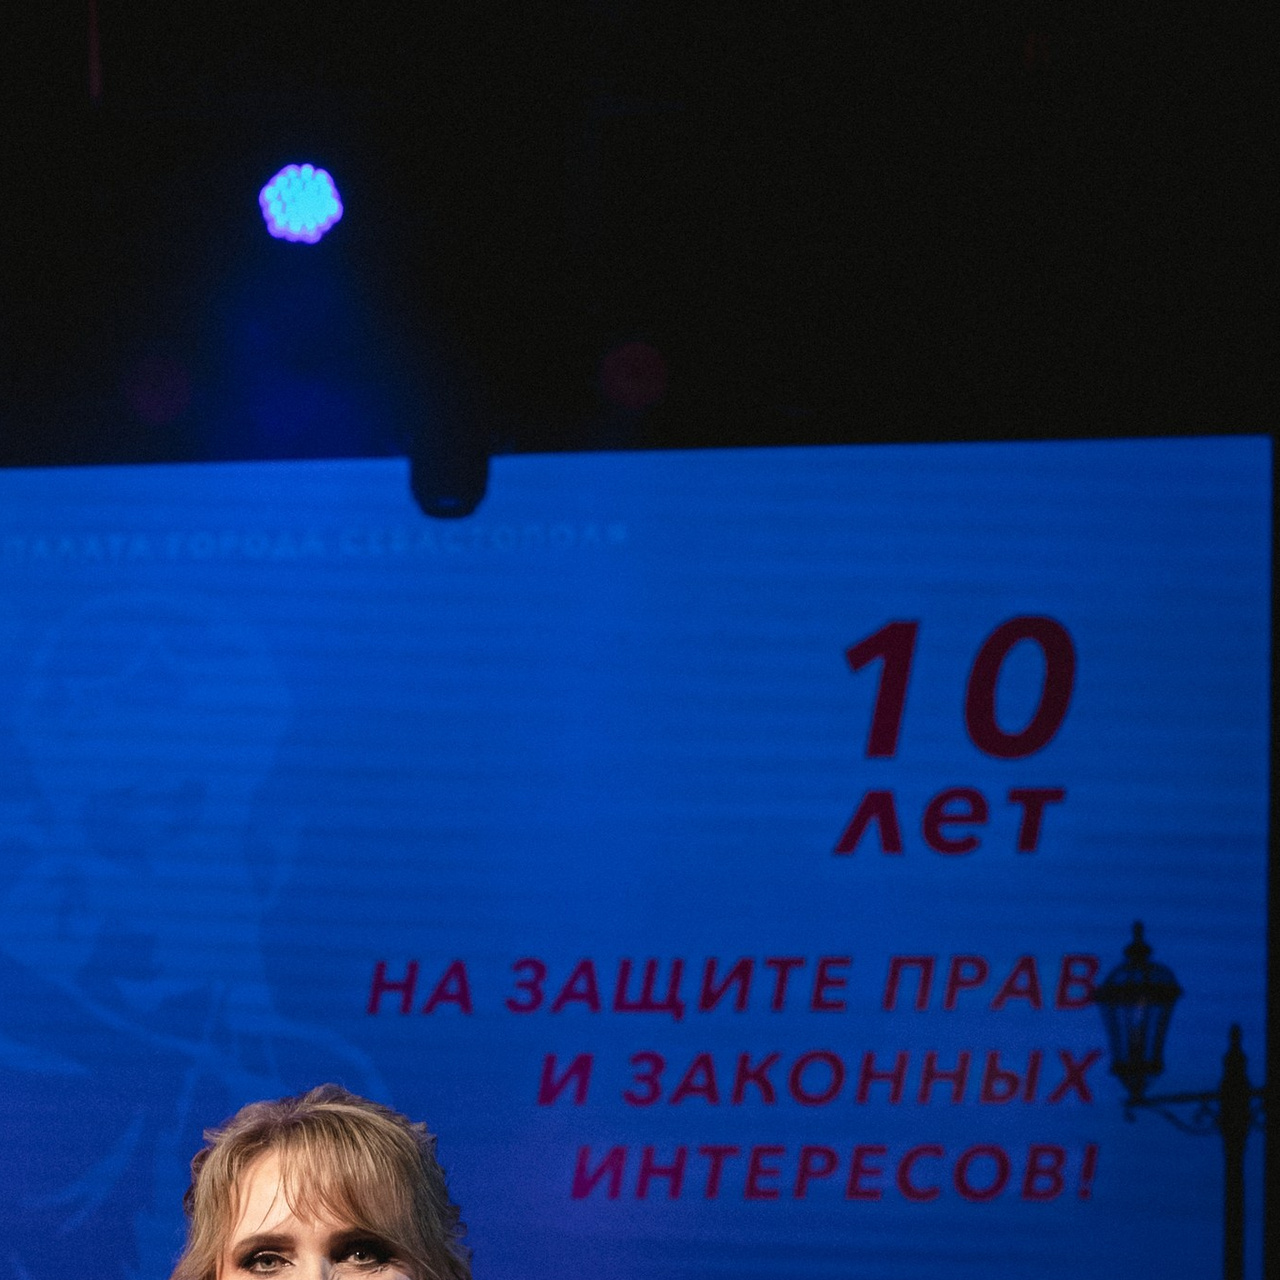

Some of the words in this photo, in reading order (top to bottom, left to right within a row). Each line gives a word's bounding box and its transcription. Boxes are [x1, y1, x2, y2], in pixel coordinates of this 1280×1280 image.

[845, 615, 1077, 759] 10
[367, 960, 473, 1013] НА
[505, 958, 852, 1021] ЗАЩИТЕ
[882, 954, 1101, 1011] ПРАВ
[536, 1054, 593, 1106] И
[623, 1050, 1104, 1106] ЗАКОННЫХ
[570, 1144, 1101, 1201] ИНТЕРЕСОВ!
